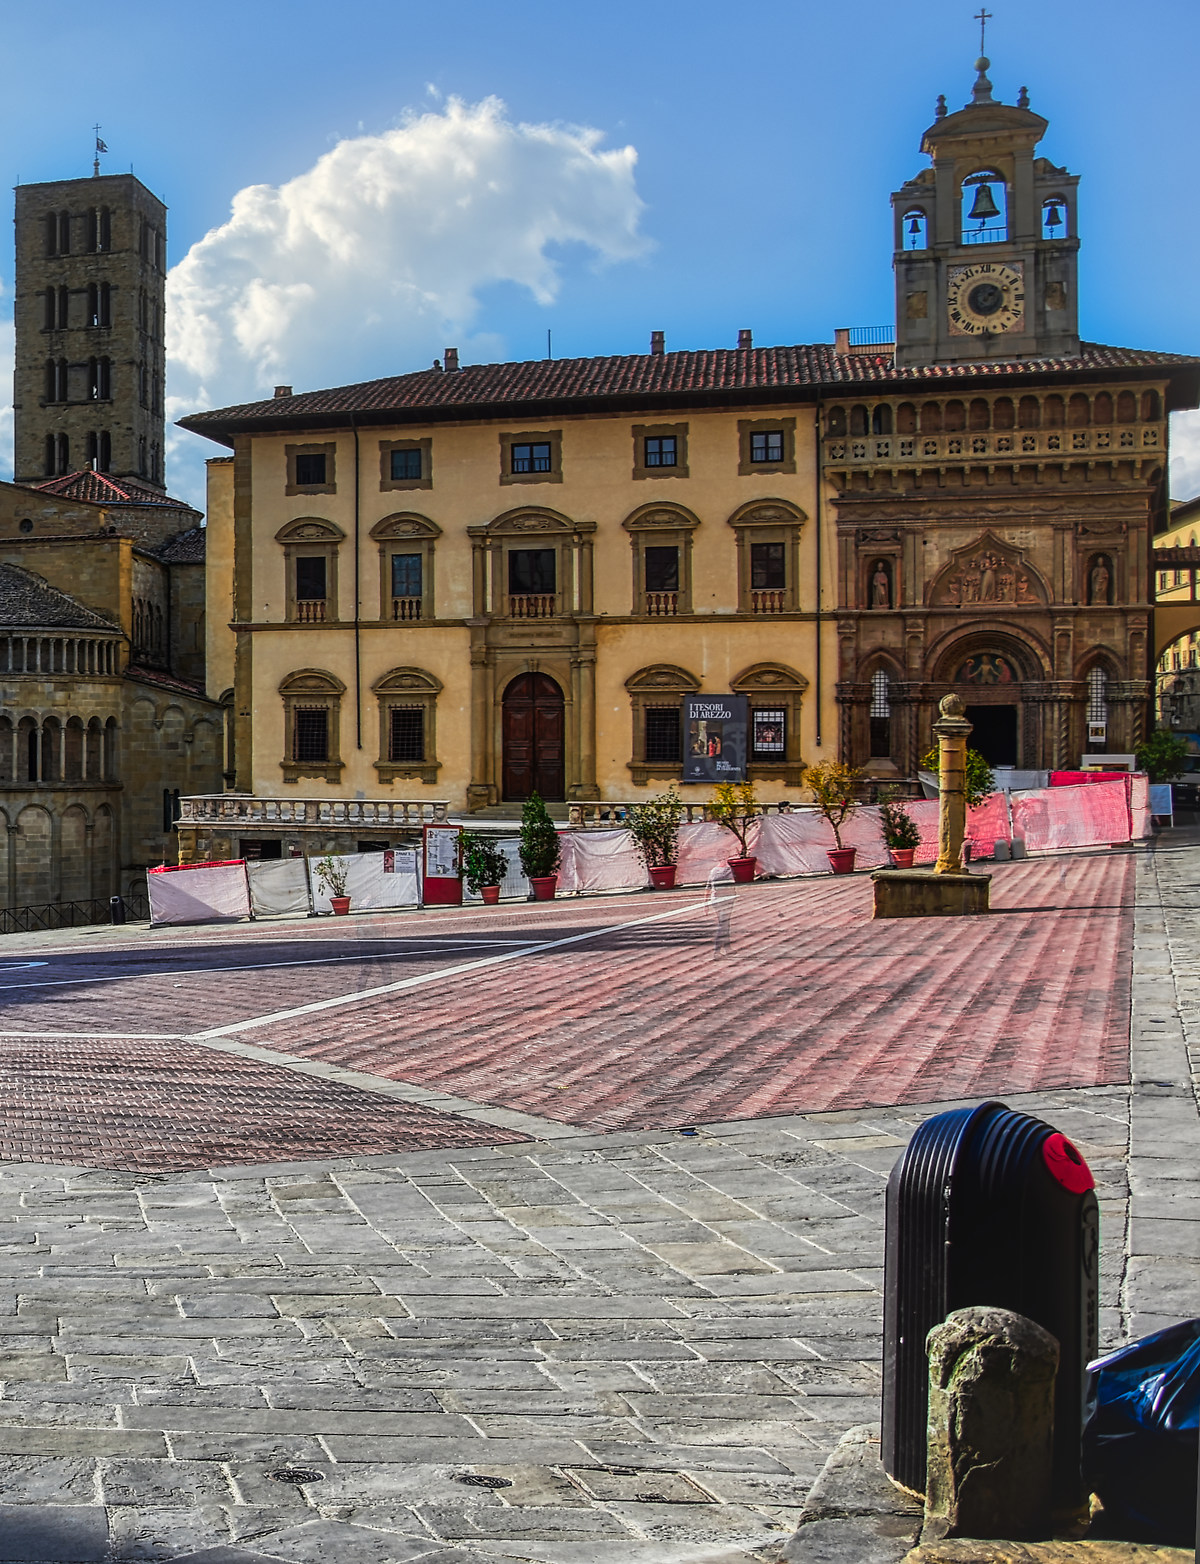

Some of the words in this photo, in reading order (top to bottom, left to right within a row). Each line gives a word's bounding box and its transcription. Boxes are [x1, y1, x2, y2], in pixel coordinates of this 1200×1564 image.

[980, 264, 991, 273] XII
[963, 268, 974, 279] XI
[947, 296, 957, 305] IX
[694, 703, 723, 711] TESORI
[700, 711, 732, 719] AREZZO
